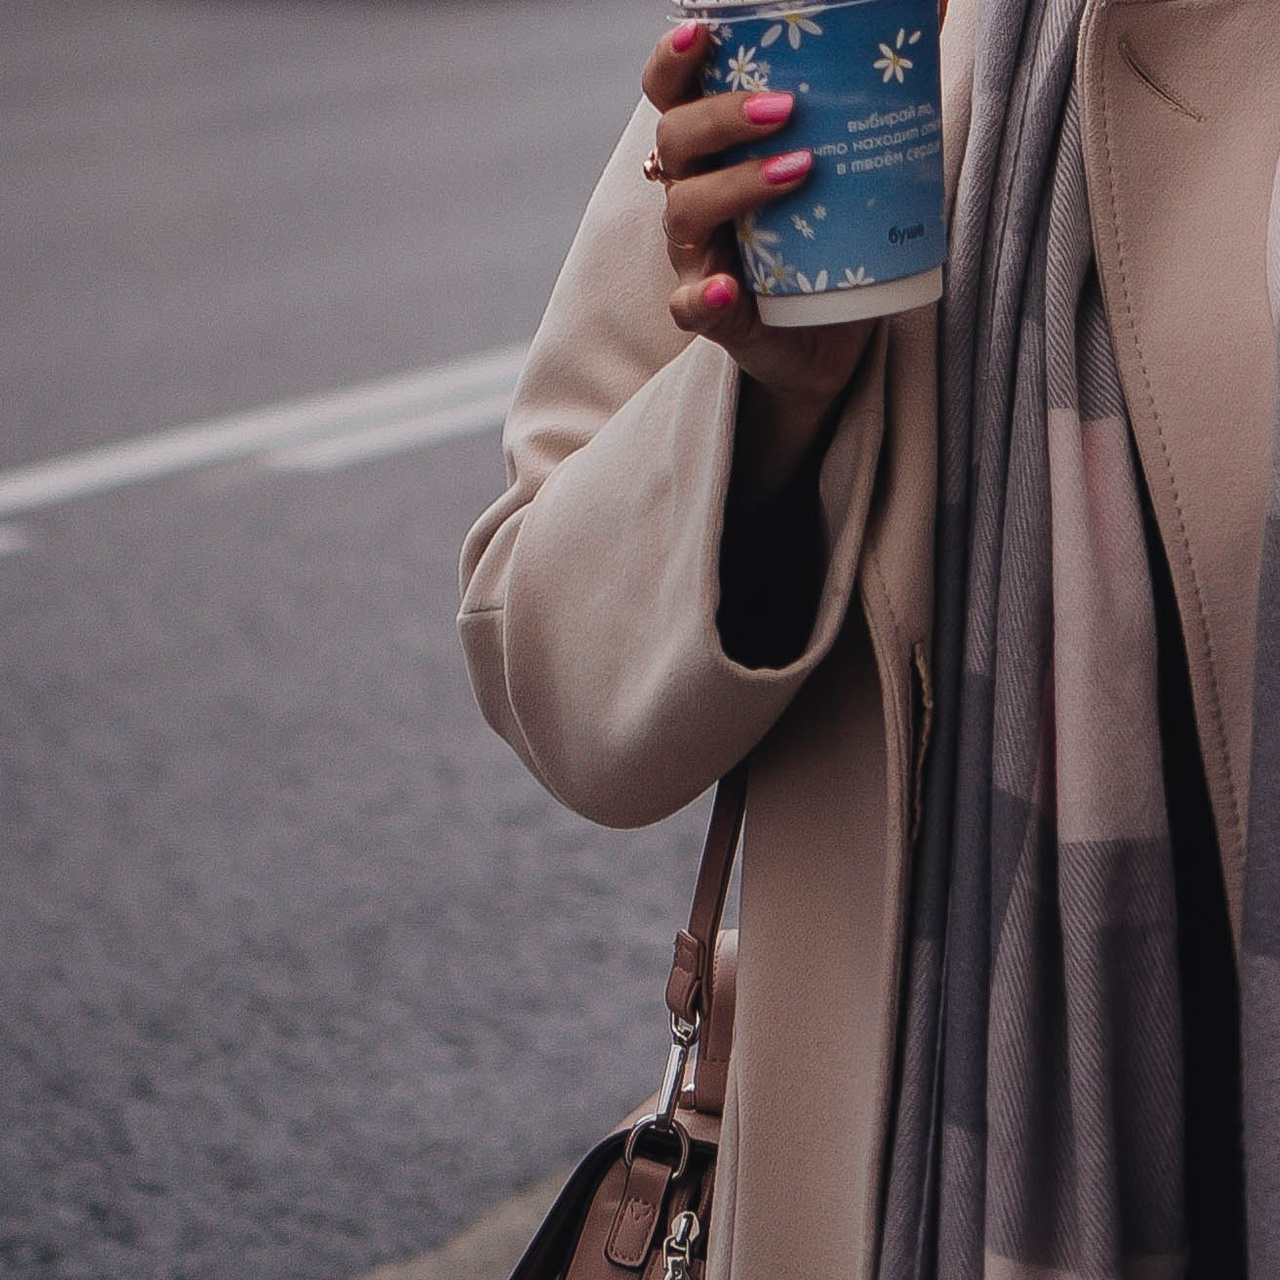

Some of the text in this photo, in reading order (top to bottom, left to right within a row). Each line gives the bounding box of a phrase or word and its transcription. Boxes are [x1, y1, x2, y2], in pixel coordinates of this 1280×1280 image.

[847, 105, 916, 133] выбирай
[813, 142, 848, 157] что
[852, 128, 920, 153] находит
[837, 161, 847, 176] в
[851, 150, 904, 174] твоём
[888, 224, 925, 246] буше
